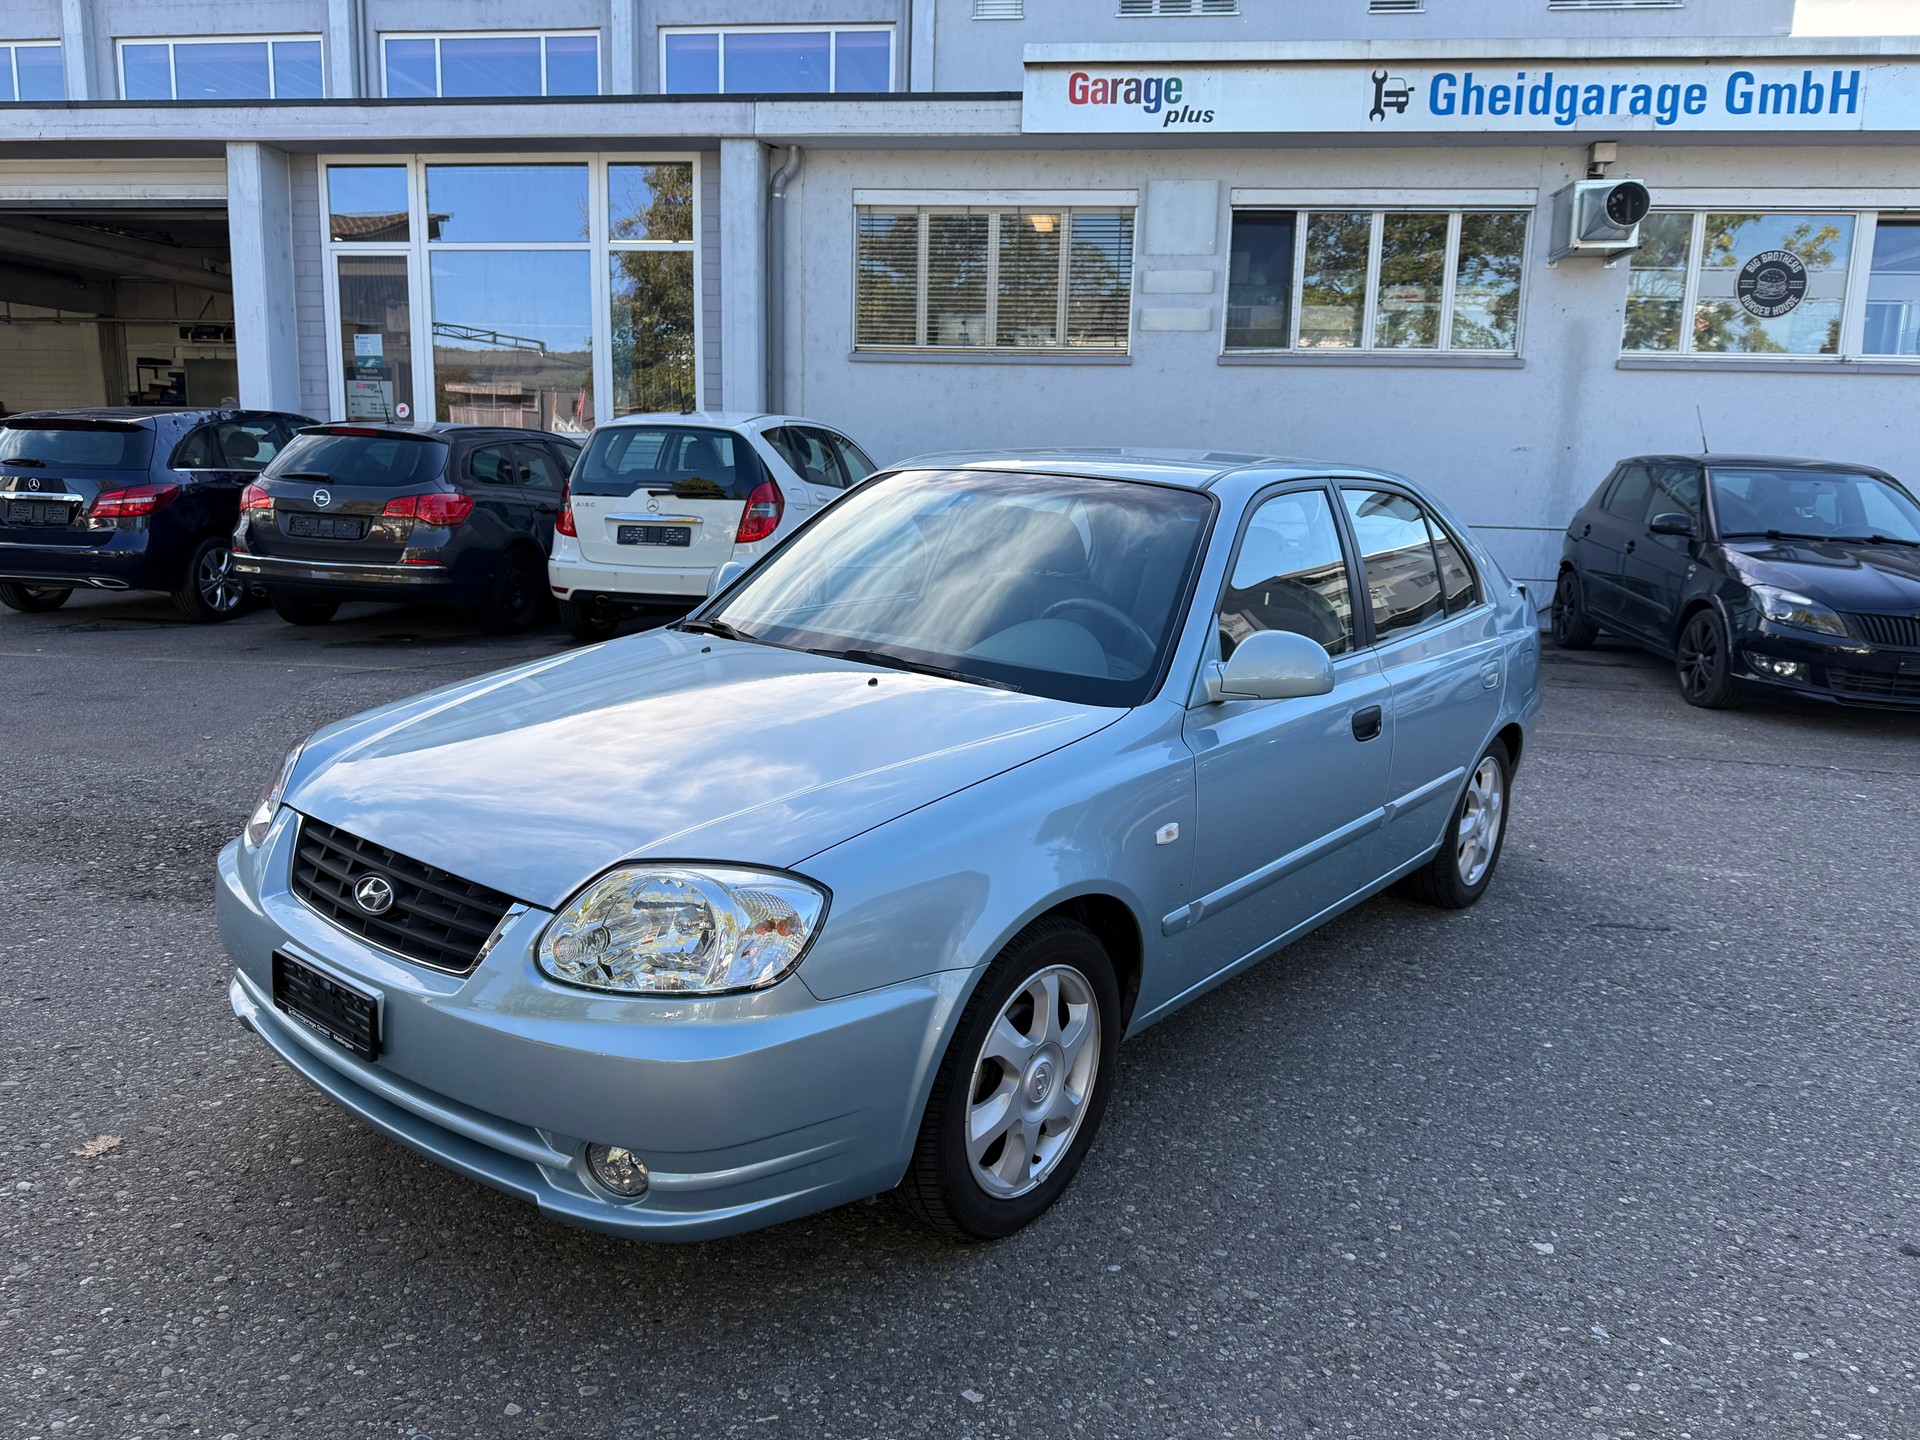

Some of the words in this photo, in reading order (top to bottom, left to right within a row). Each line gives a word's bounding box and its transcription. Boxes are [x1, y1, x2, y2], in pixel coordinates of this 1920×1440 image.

[1069, 72, 1183, 114] Garage
[1429, 71, 1707, 126] Gheidgarage
[1725, 70, 1861, 115] GmbH
[1163, 105, 1215, 127] plus
[1746, 258, 1761, 273] BIG
[1761, 252, 1802, 273] BROTHERS
[1741, 294, 1770, 316] BURGER
[1772, 294, 1799, 316] HOUSE
